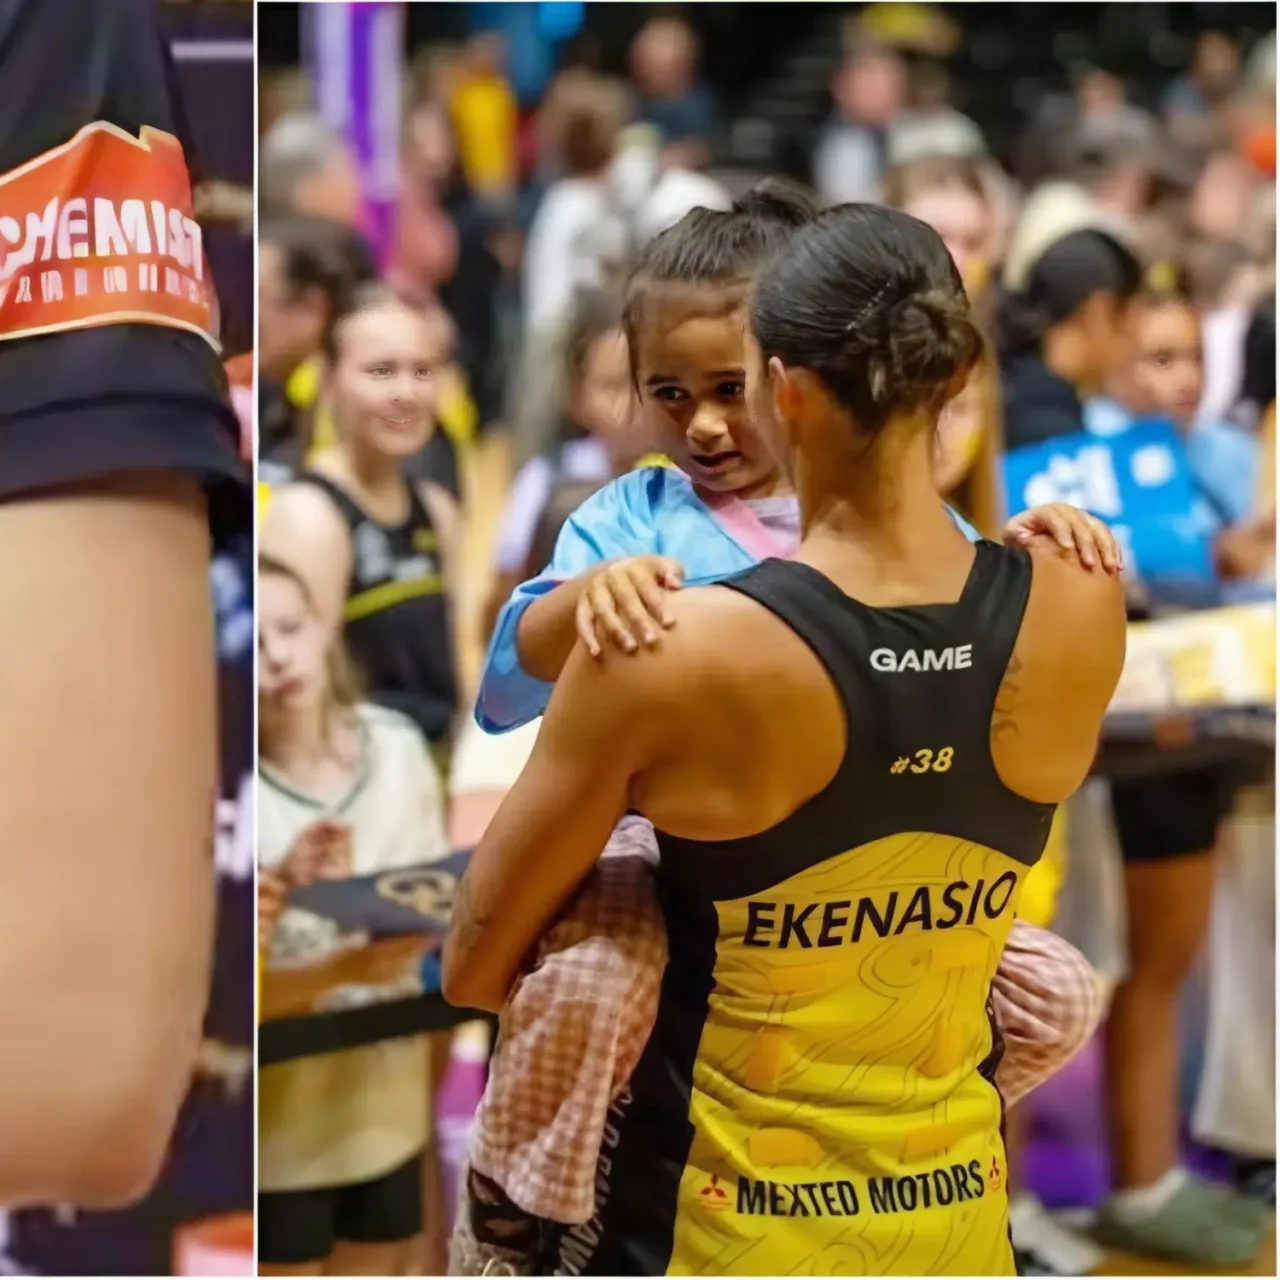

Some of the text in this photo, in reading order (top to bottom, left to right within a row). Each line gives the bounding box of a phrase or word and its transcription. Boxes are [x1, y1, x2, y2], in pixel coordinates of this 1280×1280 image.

[869, 644, 973, 673] GAME
[890, 746, 955, 775] #38
[742, 870, 1018, 950] EKENASIO
[736, 1159, 985, 1217] MEXTED MOTORS
